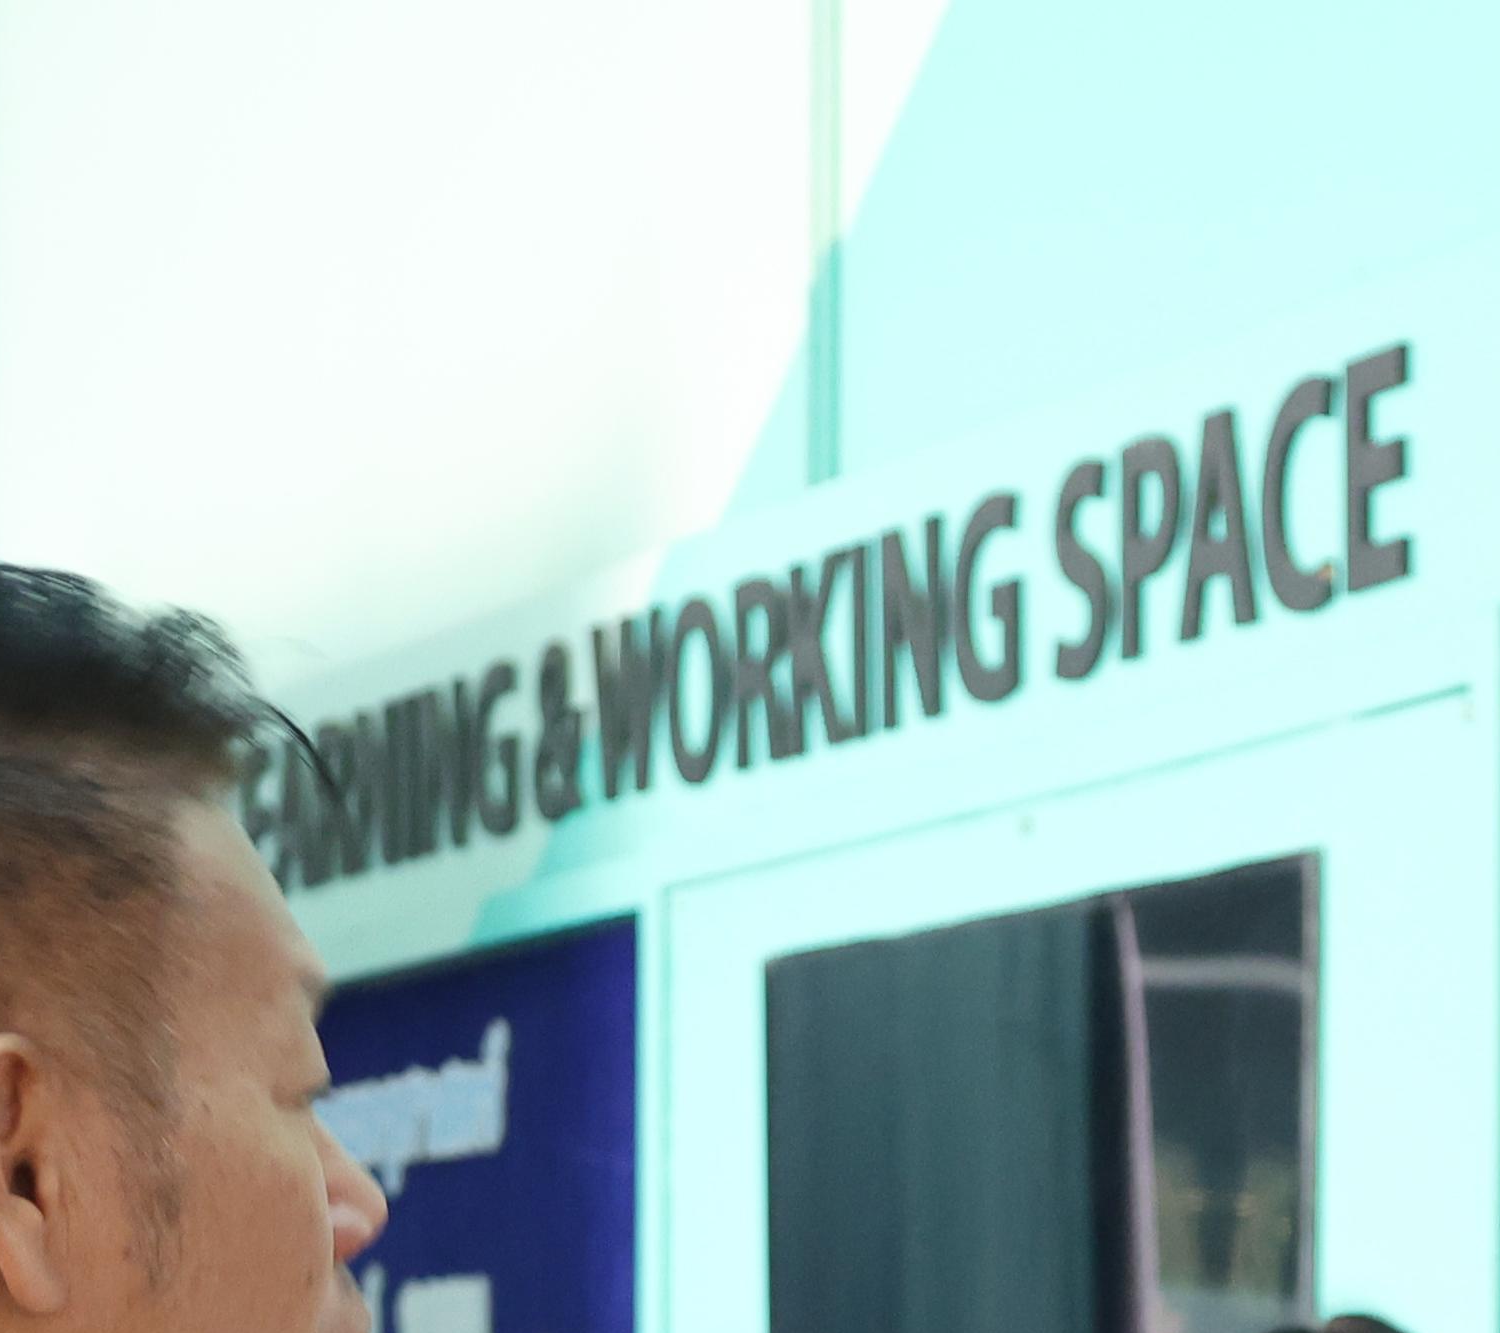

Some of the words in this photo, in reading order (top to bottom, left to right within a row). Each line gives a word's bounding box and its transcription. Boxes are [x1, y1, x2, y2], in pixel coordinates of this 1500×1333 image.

[238, 660, 520, 888] EARNING
[592, 493, 1020, 798] WORKING
[1055, 343, 1409, 680] SPACE
